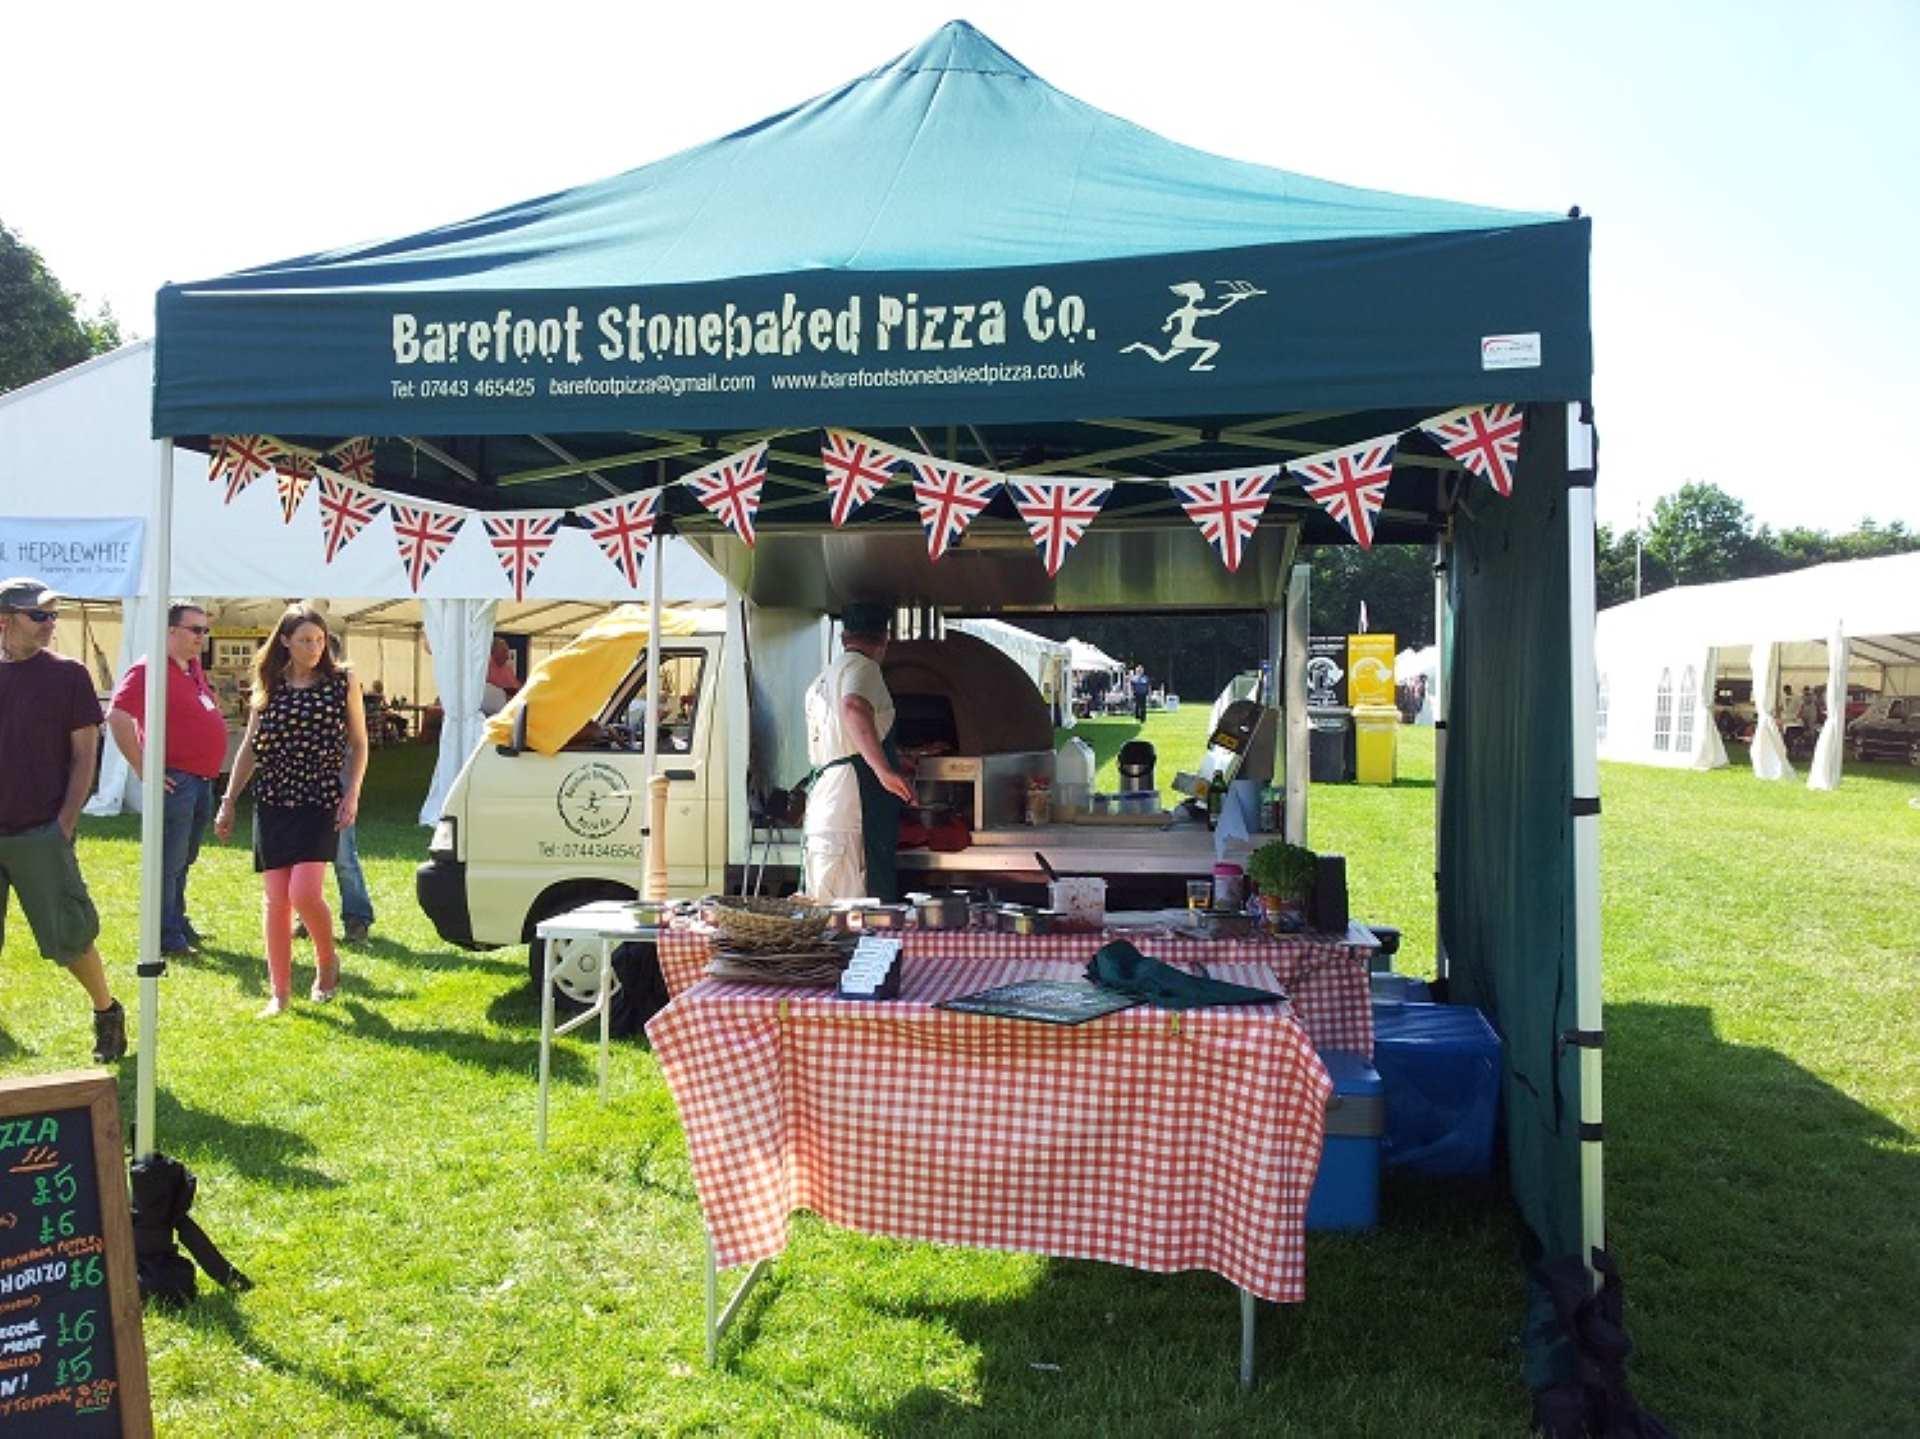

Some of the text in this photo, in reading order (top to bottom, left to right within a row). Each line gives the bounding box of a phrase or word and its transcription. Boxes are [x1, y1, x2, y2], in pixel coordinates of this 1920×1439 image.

[392, 285, 1096, 365] Barefoot Stonebaked Pizza Co.
[421, 380, 469, 398] 07443
[475, 378, 535, 397] 465425
[550, 373, 756, 397] barefootpizza@gmail.com
[771, 359, 1086, 390] www.barefootstonebakedpizza.co.uk
[18, 541, 130, 563] HEPPLEWHITE
[32, 1163, 77, 1206] £5
[39, 1210, 76, 1244] £6
[57, 1309, 96, 1347] £6
[55, 1345, 92, 1386] £5
